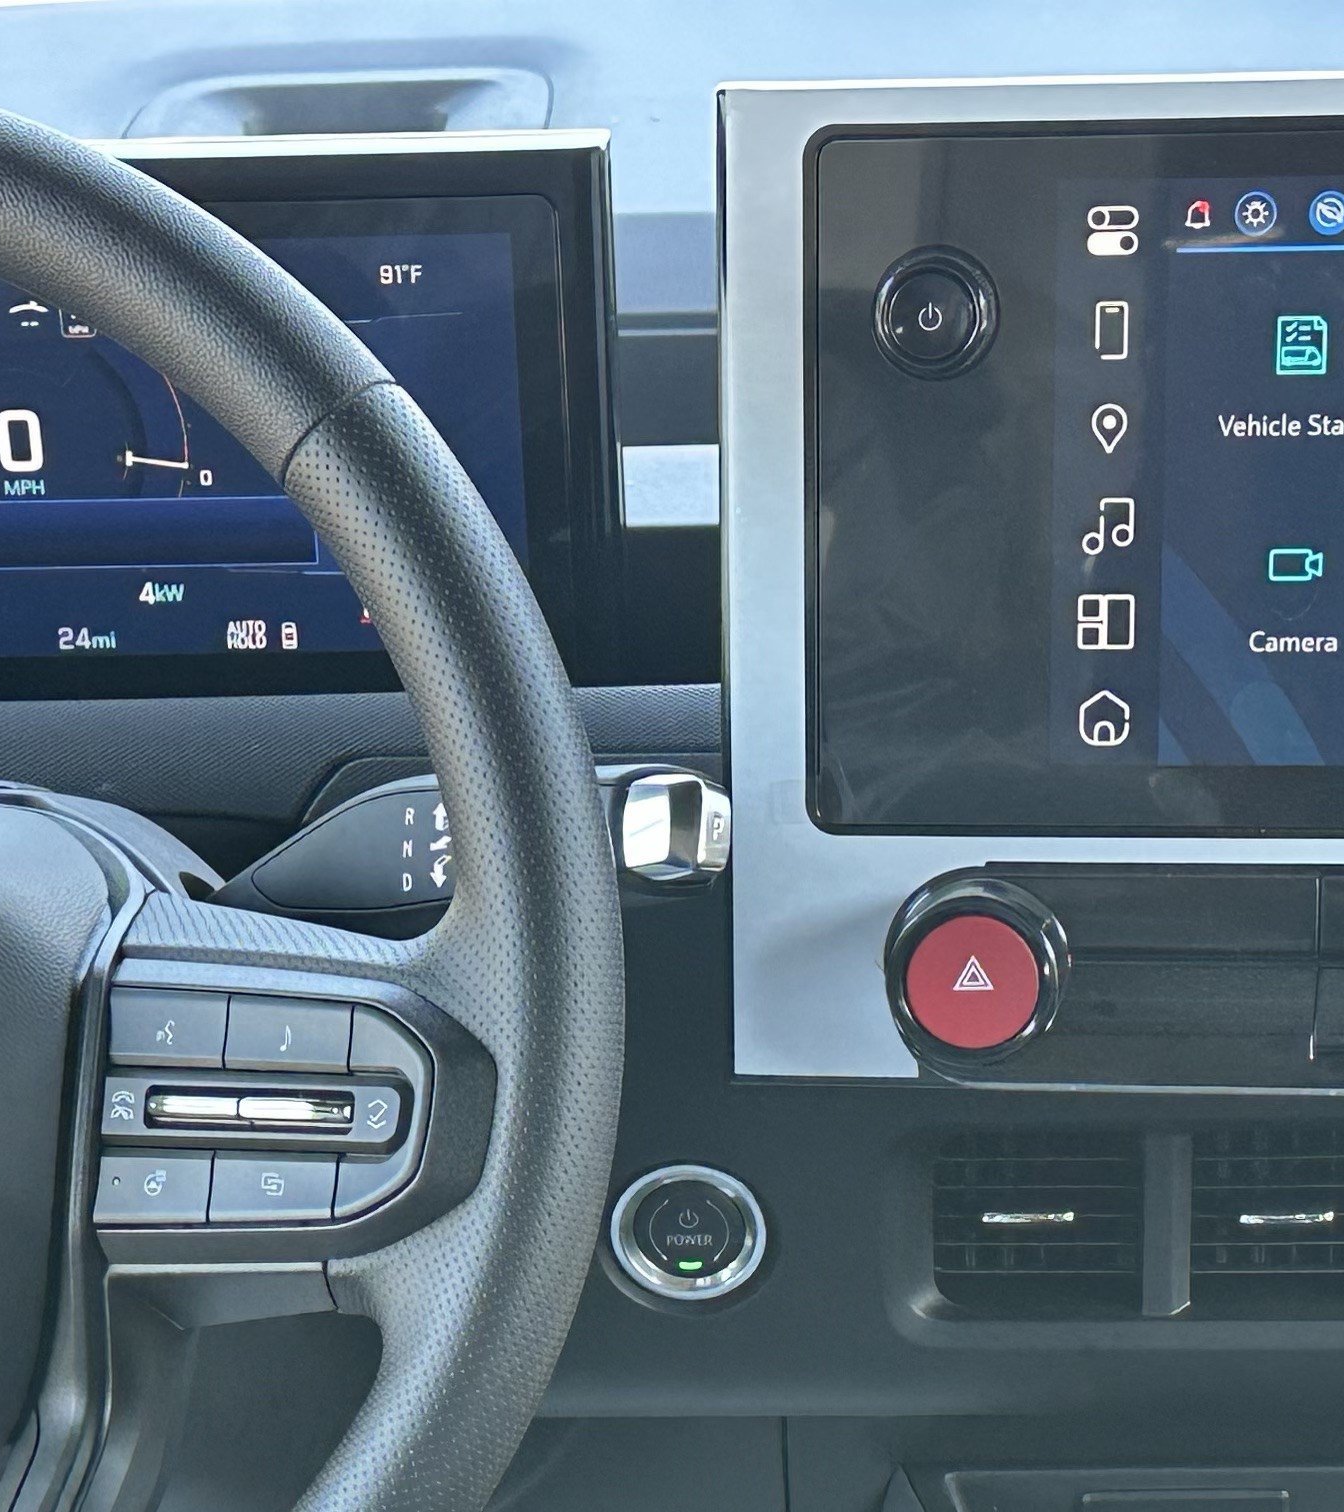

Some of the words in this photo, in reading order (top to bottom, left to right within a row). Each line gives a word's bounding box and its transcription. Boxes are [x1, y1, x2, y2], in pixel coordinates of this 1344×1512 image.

[379, 264, 423, 285] 91°F
[1218, 412, 1302, 437] Vehicle
[3, 479, 46, 496] MPH
[199, 469, 213, 487] 0
[138, 581, 185, 605] 4kW
[57, 626, 117, 650] 24mi
[1248, 630, 1338, 653] Camera
[404, 807, 415, 826] R
[402, 839, 413, 858] N
[402, 872, 413, 892] D
[666, 1234, 713, 1247] POWER
